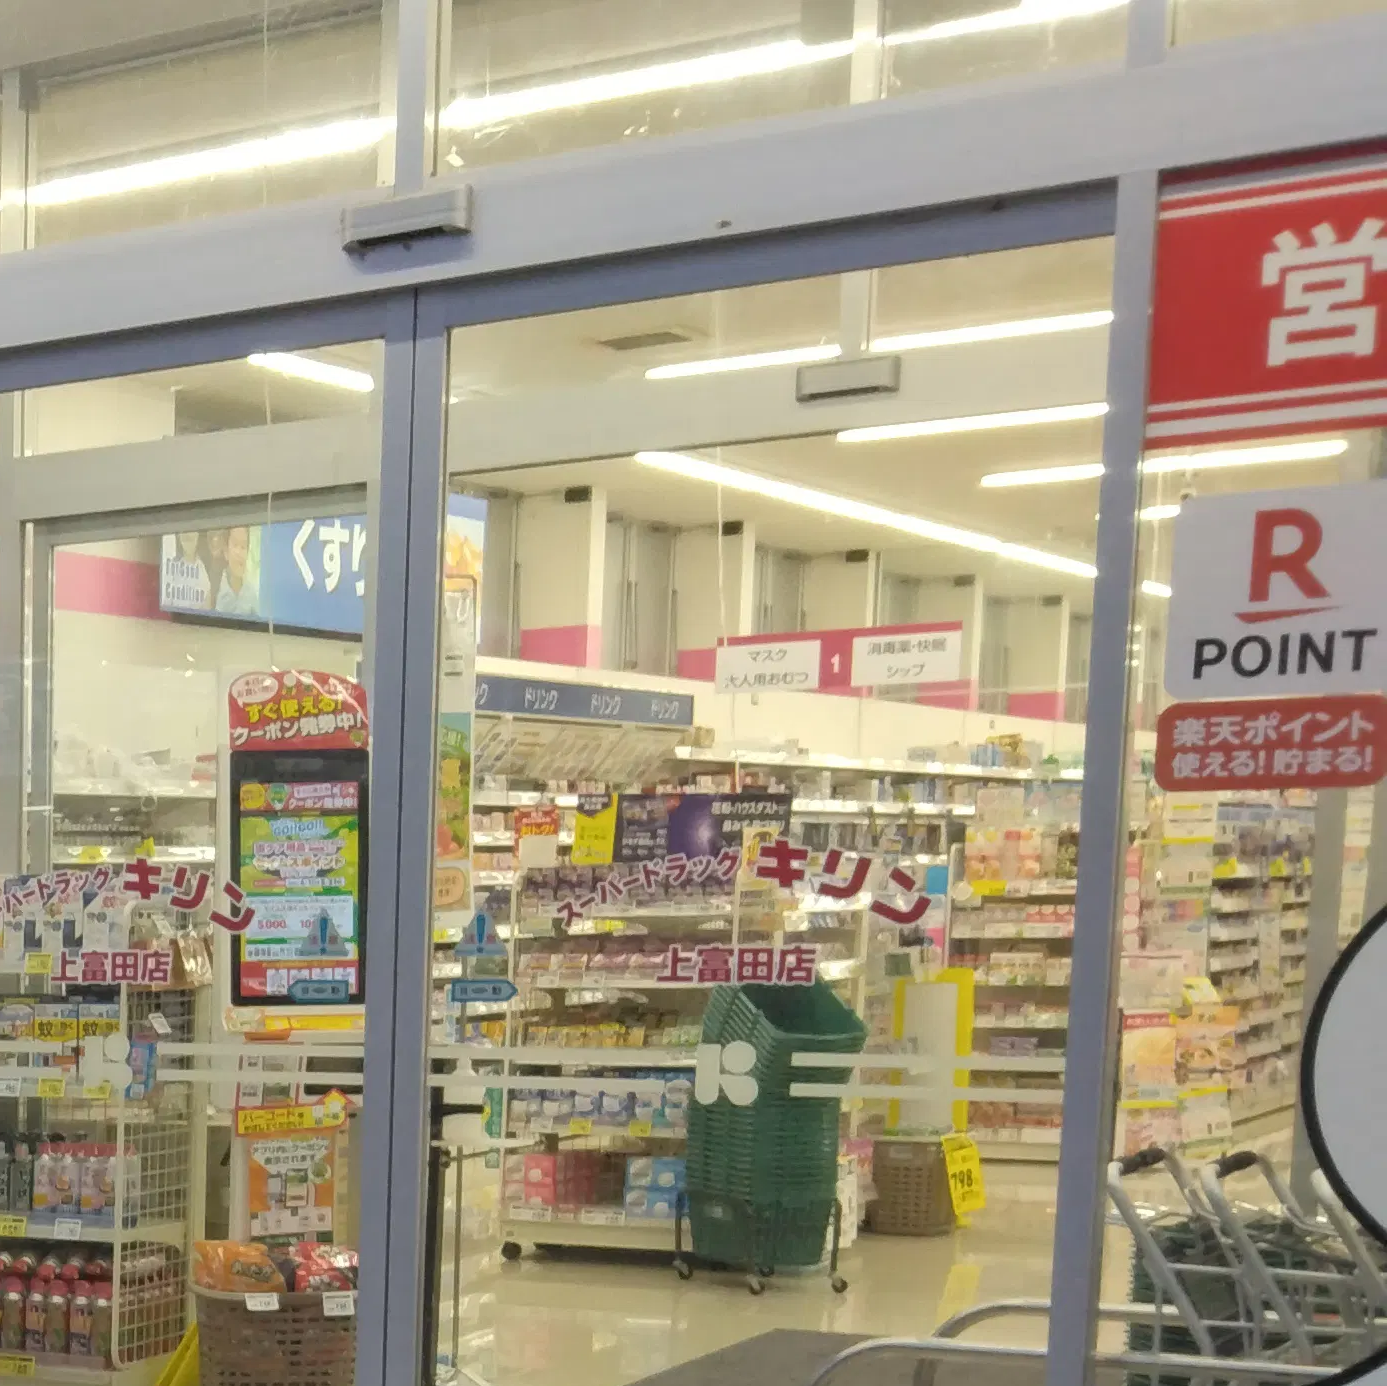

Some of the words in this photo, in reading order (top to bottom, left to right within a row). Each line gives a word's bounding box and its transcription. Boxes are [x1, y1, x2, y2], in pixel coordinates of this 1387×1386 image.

[1248, 508, 1331, 602] R
[747, 648, 786, 663] マスク
[830, 654, 842, 674] 1
[1192, 628, 1378, 680] POINT
[723, 671, 809, 689] 大人用おむつ
[885, 663, 926, 679] シップ
[524, 689, 559, 711] ドリンク
[590, 692, 623, 715] ドリンク
[650, 698, 680, 721] ドリンク
[1173, 709, 1375, 748] 楽天ポイント
[123, 857, 256, 932] キリン
[556, 846, 742, 929] スーパードラッグ
[755, 838, 933, 925] キリン
[51, 949, 173, 984] 上富田店
[655, 945, 817, 984] 上富田店
